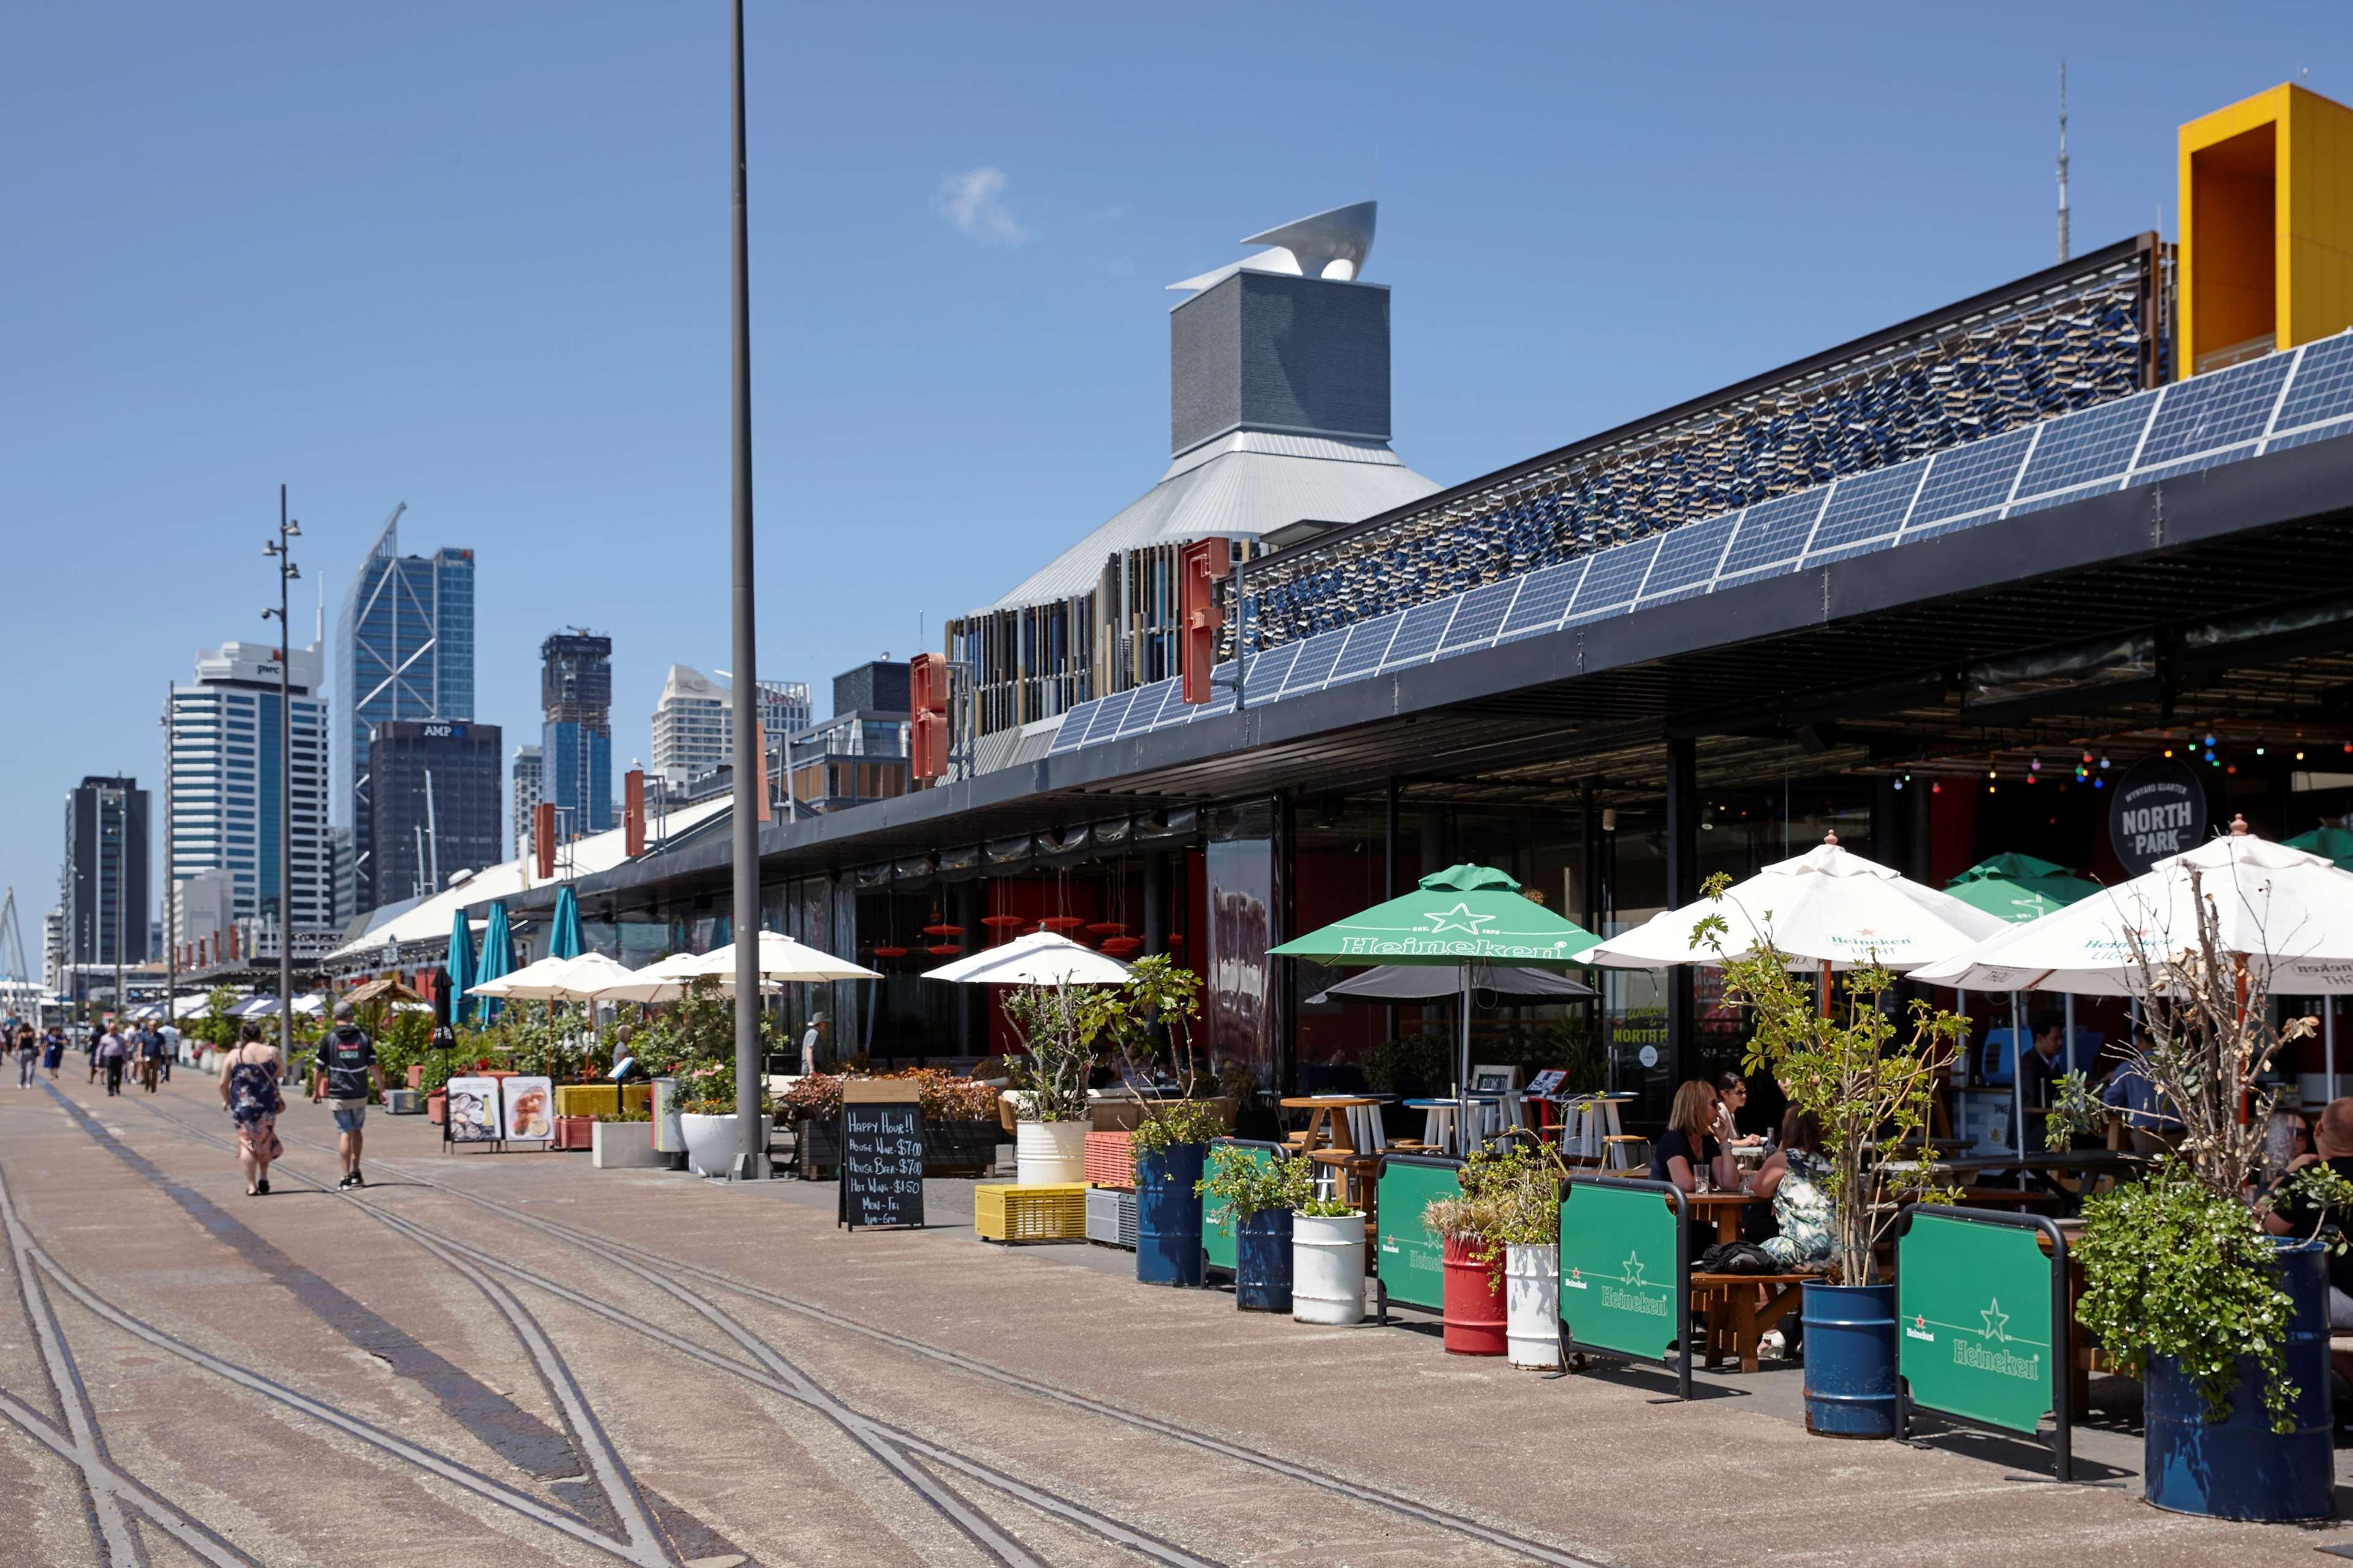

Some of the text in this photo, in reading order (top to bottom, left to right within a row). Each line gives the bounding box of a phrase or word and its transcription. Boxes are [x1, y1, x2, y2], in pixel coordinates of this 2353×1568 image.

[424, 725, 452, 737] AMP
[2123, 801, 2192, 835] NORTH
[2135, 829, 2179, 855] PARK
[1339, 936, 1566, 960] Heineken
[1831, 936, 1912, 944] Heineken
[1613, 1029, 1657, 1043] NORTH
[1602, 1286, 1667, 1317] Heineken
[1953, 1339, 2039, 1381] Heineken
